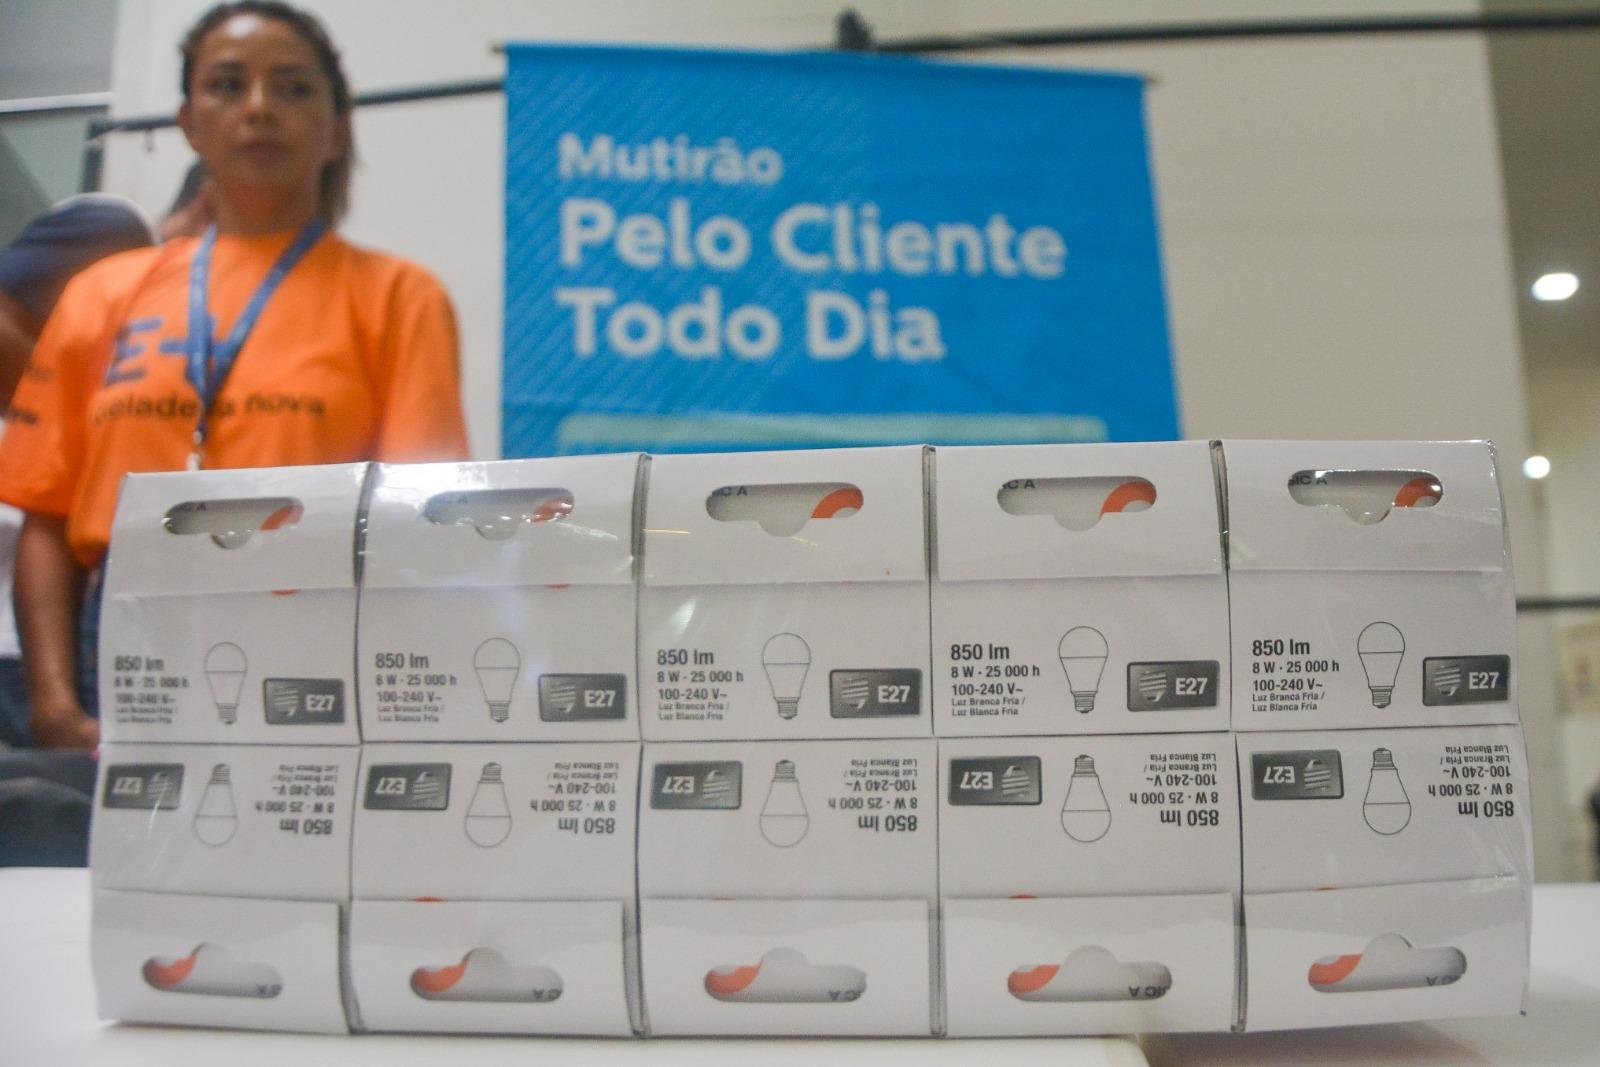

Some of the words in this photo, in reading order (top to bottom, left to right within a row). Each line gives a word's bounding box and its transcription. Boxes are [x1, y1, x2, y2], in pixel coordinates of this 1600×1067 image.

[558, 133, 784, 186] Mutirão
[559, 200, 753, 271] Pelo
[771, 202, 1068, 279] Cliente
[554, 286, 782, 360] Todo
[806, 290, 946, 360] Dia
[951, 645, 982, 660] 850
[989, 644, 1010, 659] lm
[1252, 640, 1284, 656] 850
[1290, 639, 1310, 655] lm
[657, 650, 687, 665] 850
[694, 649, 714, 664] lm
[951, 667, 958, 678] 8
[962, 667, 974, 677] W
[986, 666, 1000, 677] 25
[1005, 666, 1028, 676] 000
[1033, 665, 1040, 676] h
[1253, 663, 1259, 673] 8
[1263, 663, 1275, 672] W
[1287, 662, 1301, 672] 25
[1306, 662, 1328, 672] 000
[1333, 661, 1339, 671] h
[657, 672, 664, 682] 8
[669, 672, 680, 682] W
[691, 671, 705, 682] 25
[710, 671, 732, 682] 000
[736, 671, 743, 681] h
[1469, 672, 1499, 689] E27
[952, 684, 1003, 695] 100-240
[1176, 678, 1208, 694] E27
[1253, 680, 1306, 691] 100-240
[584, 690, 616, 707] E27
[659, 689, 708, 699] 100-240
[878, 686, 910, 702] E27
[1494, 745, 1508, 753] Luz
[1263, 766, 1295, 783] E27
[1462, 766, 1511, 777] 100-240
[661, 776, 694, 794] E27
[961, 771, 993, 789] E27
[1164, 774, 1216, 785] 100-240
[1429, 785, 1435, 796] h
[1440, 784, 1461, 795] 000
[1466, 784, 1480, 795] 25
[1491, 784, 1502, 794] W
[1506, 783, 1512, 794] 8
[841, 798, 863, 808] 000
[868, 798, 882, 808] 25
[895, 797, 905, 808] W
[911, 797, 917, 808] 8
[1130, 793, 1137, 803] h
[1141, 793, 1165, 803] 000
[1169, 793, 1184, 803] 25
[1196, 793, 1208, 803] W
[1212, 792, 1218, 803] 8
[1458, 801, 1478, 817] lm
[1484, 801, 1514, 817] 850
[886, 815, 917, 831] 850
[1160, 810, 1181, 826] lm
[1187, 809, 1219, 826] 850
[858, 816, 879, 831] lm
